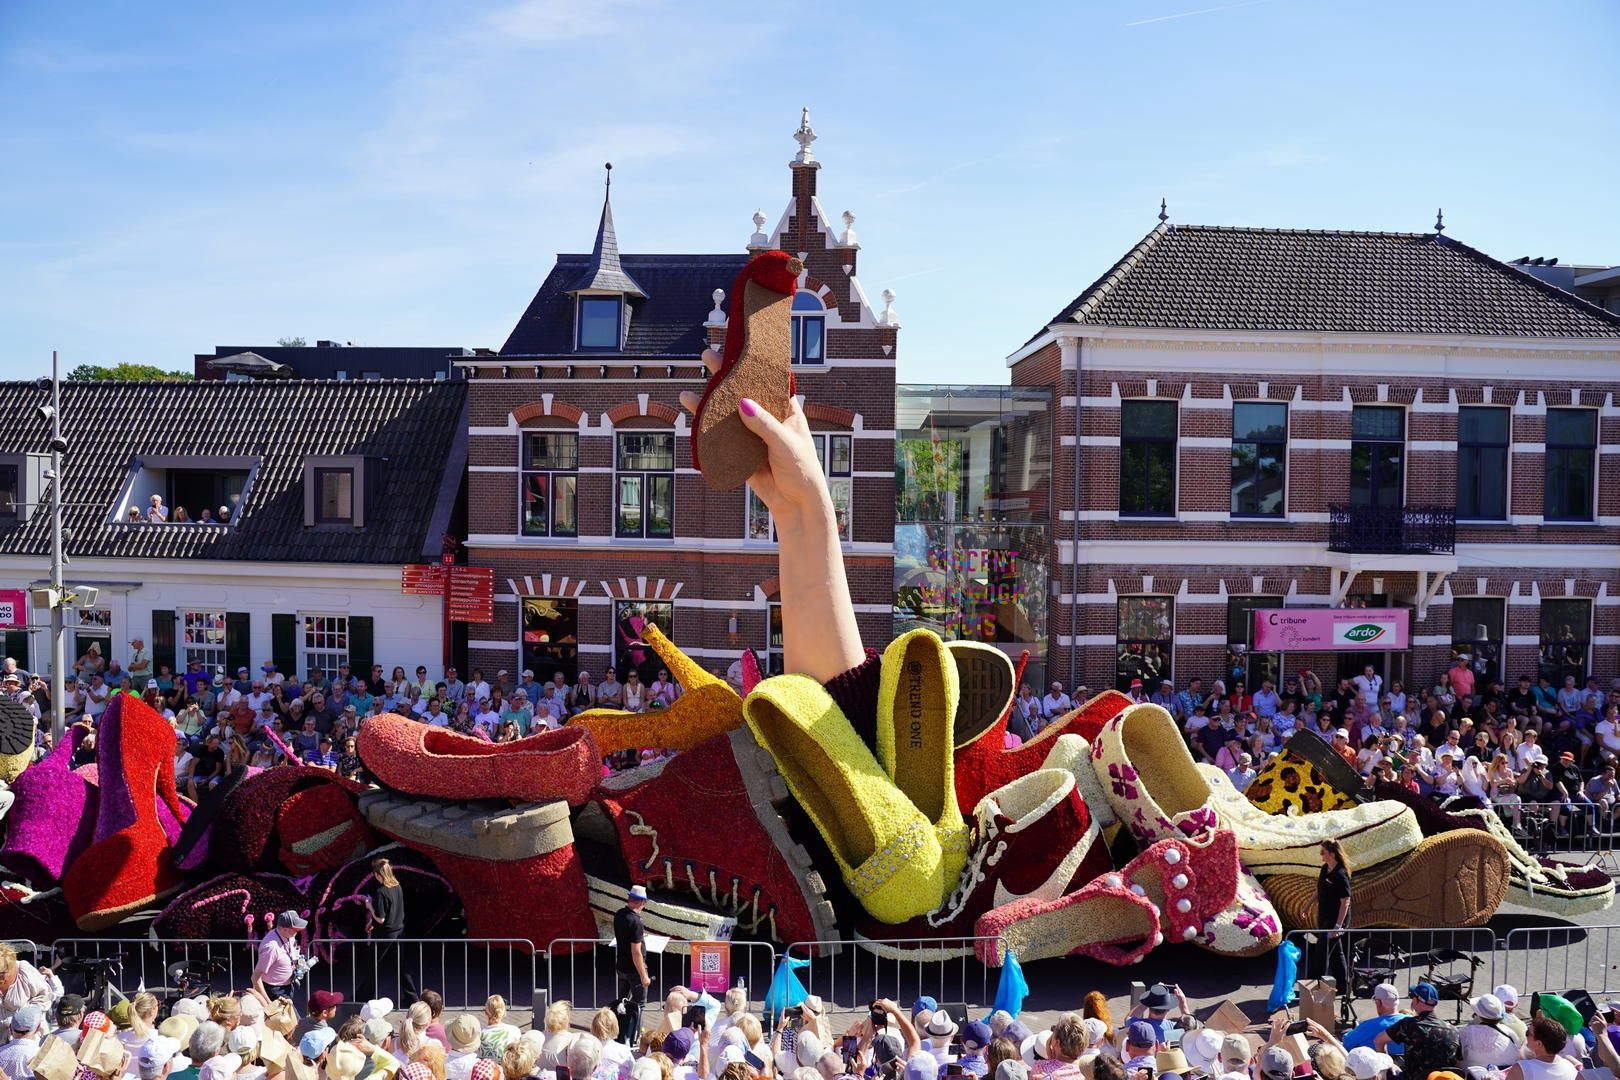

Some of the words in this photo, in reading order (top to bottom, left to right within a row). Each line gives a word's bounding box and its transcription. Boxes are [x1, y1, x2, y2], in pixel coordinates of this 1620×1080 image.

[928, 549, 1019, 573] VINCENT
[920, 582, 960, 604] VAN
[968, 582, 1026, 605] GOGH
[946, 613, 997, 636] HUIS
[1269, 613, 1278, 626] C
[1349, 627, 1377, 637] ardo
[909, 676, 922, 718] TREND
[910, 721, 922, 748] ONE
